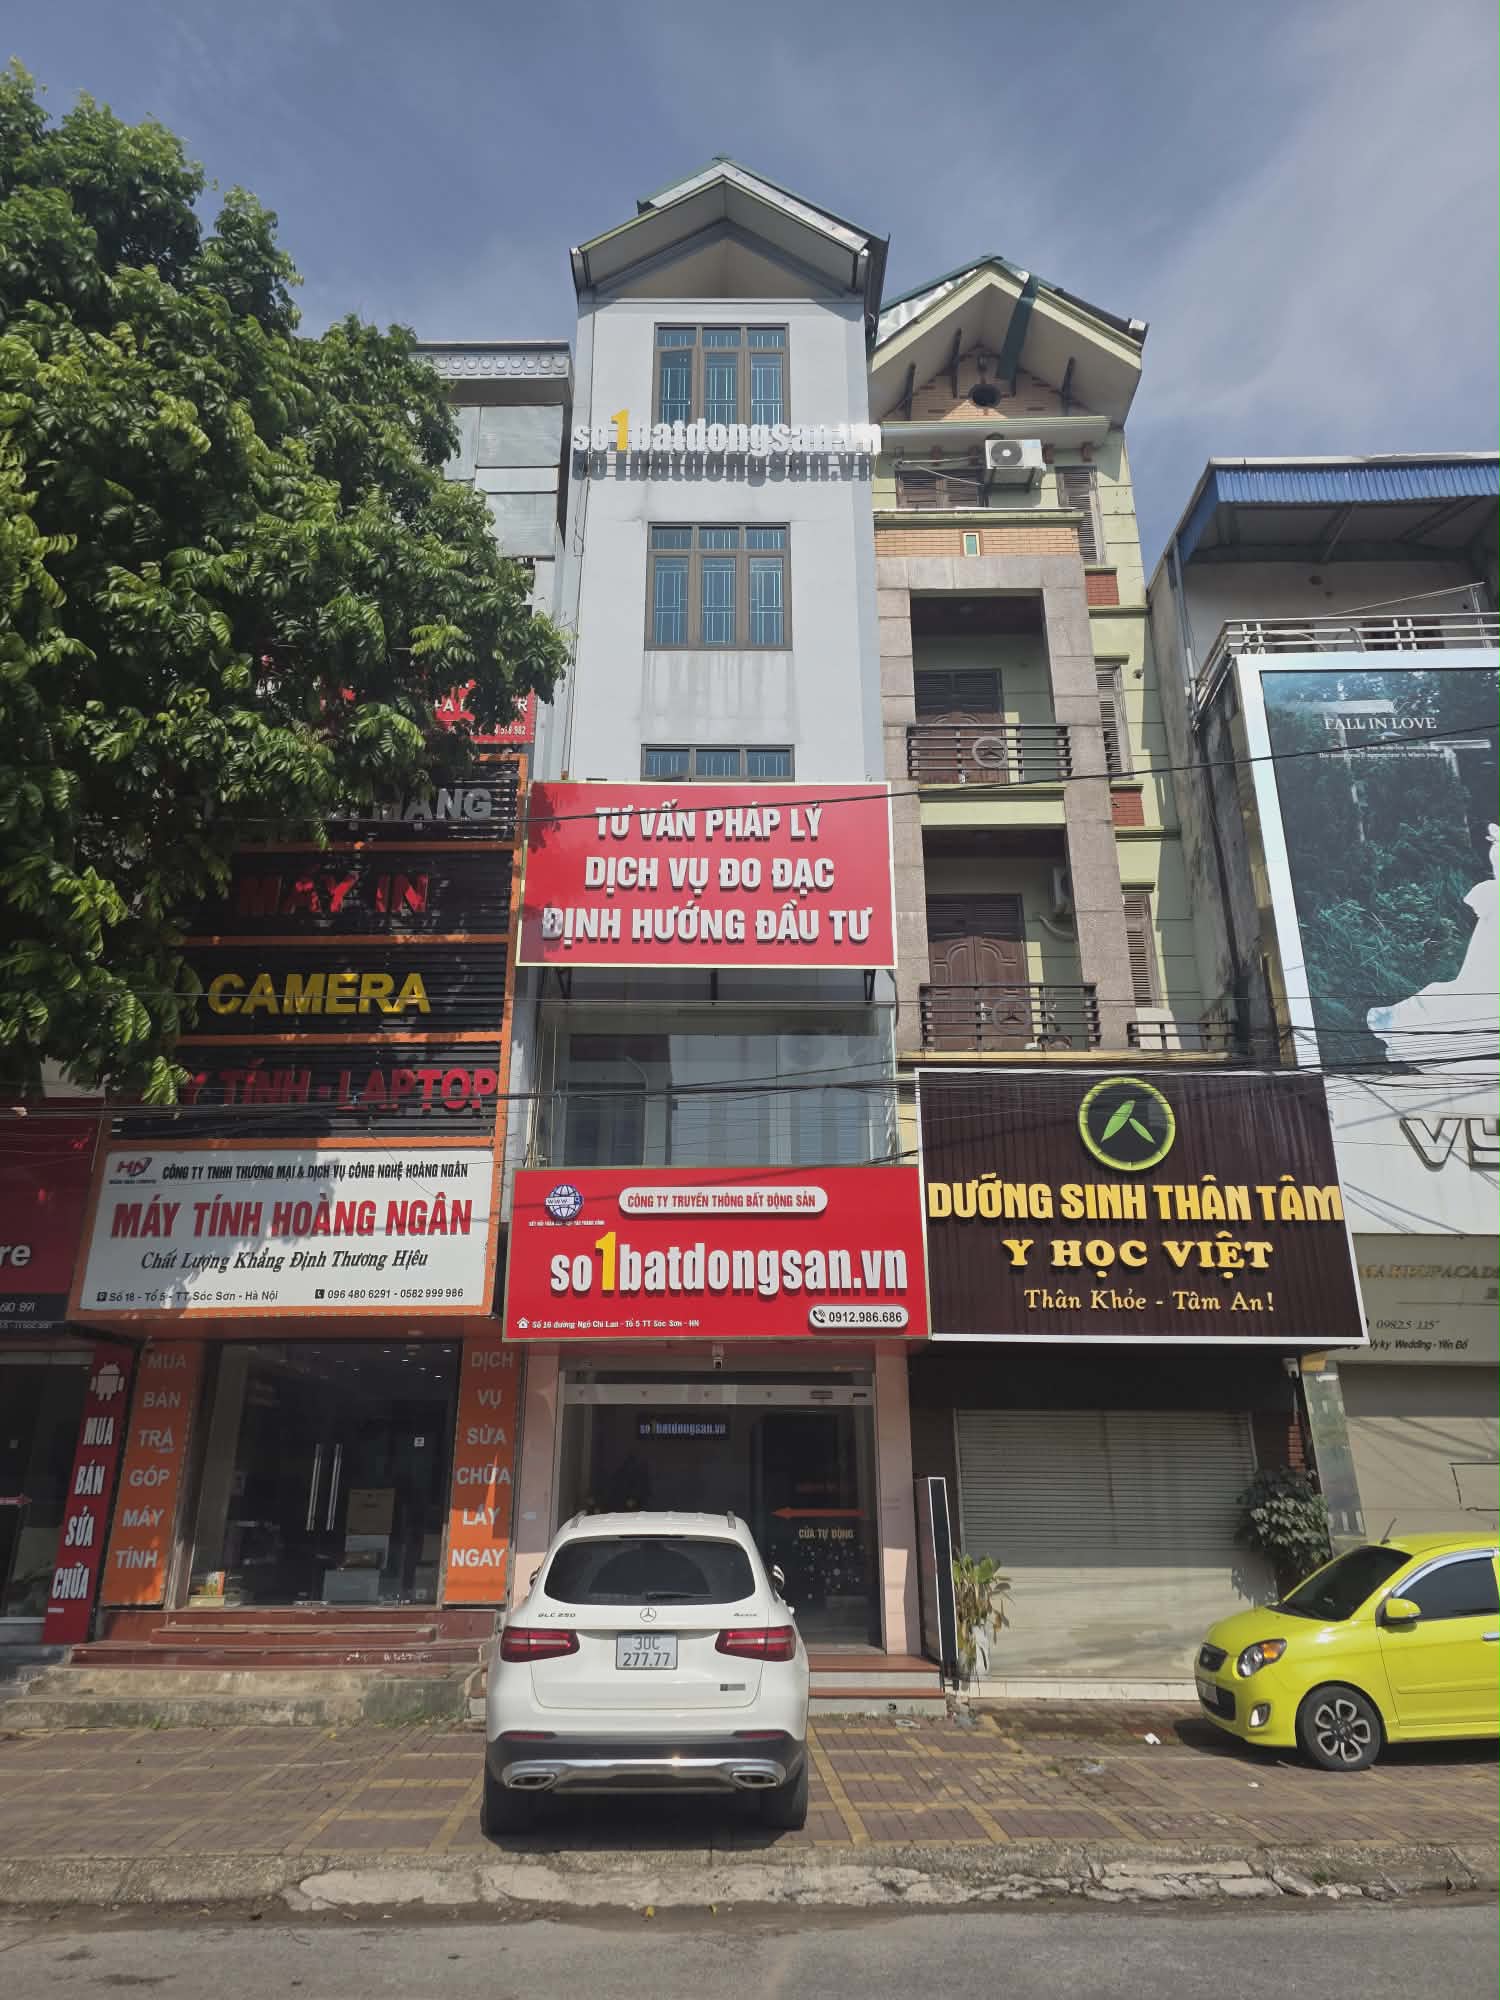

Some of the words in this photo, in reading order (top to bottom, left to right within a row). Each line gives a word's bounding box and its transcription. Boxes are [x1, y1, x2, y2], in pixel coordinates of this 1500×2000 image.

[1368, 717, 1390, 730] IN
[1391, 716, 1437, 729] LOVE
[595, 804, 633, 837] TƯ
[640, 799, 696, 837] VẤN
[705, 802, 780, 837] PHÁP
[790, 802, 822, 837] LÝ
[585, 856, 658, 895] DỊCH
[668, 857, 708, 895] VỤ
[719, 857, 762, 889] ĐO
[771, 857, 834, 896] ĐẠC
[542, 907, 621, 944] ĐỊNH
[632, 901, 745, 940] HƯỚNG
[828, 907, 873, 940] TƯ
[207, 973, 432, 1015] CAMERA
[220, 1058, 312, 1105] TÍNH
[336, 1067, 499, 1111] LAPTOP
[162, 1163, 189, 1180] CÔNG
[191, 1166, 204, 1180] TY
[207, 1165, 233, 1180] TNHH
[236, 1163, 274, 1180] THƯƠNG
[276, 1165, 296, 1182] MẠI
[307, 1165, 331, 1182] DỊCH
[333, 1165, 346, 1182] VỤ
[349, 1162, 375, 1179] CÔNG
[377, 1161, 403, 1181] NGHỆ
[405, 1161, 438, 1179] HOÀNG
[440, 1160, 468, 1178] NGÂN
[628, 1192, 654, 1208] CÔNG
[656, 1195, 669, 1208] TY
[712, 1192, 743, 1208] THÔNG
[746, 1191, 764, 1208] BẤT
[767, 1192, 793, 1210] ĐỘNG
[795, 1191, 816, 1208] SẢN
[928, 1173, 1054, 1219] DƯỠNG
[1060, 1184, 1147, 1220] SINH
[1153, 1174, 1252, 1221] THÂN
[1256, 1175, 1344, 1221] TÂM
[110, 1193, 181, 1238] MÁY
[191, 1193, 262, 1238] TÍNH
[270, 1192, 377, 1238] HOÀNG
[385, 1191, 473, 1236] NGÂN
[141, 1248, 178, 1269] Chất
[181, 1252, 231, 1273] Lượng
[233, 1247, 285, 1272] Khẳng
[289, 1250, 327, 1271] Định
[331, 1251, 388, 1271] Thương
[550, 1231, 908, 1296] so1batdongsan.vn
[1002, 1239, 1034, 1267] Y
[1050, 1239, 1148, 1278] HỌC
[1161, 1231, 1274, 1279] VIỆT
[125, 1292, 135, 1302] 18
[175, 1291, 190, 1302] TT
[192, 1291, 213, 1302] Sóc
[215, 1291, 236, 1301] Sơn
[245, 1291, 258, 1301] Hà
[261, 1290, 279, 1302] Nội
[327, 1289, 346, 1299] 096
[348, 1289, 366, 1299] 480
[368, 1289, 391, 1299] 6291
[400, 1289, 424, 1298] 0582
[425, 1288, 444, 1298] 999
[445, 1288, 464, 1298] 986
[1024, 1289, 1082, 1310] Thân
[1090, 1287, 1147, 1310] Khỏe
[1172, 1290, 1221, 1312] Tâm
[1231, 1291, 1275, 1312] An!
[828, 1311, 903, 1323] 0912.986.686
[148, 1353, 187, 1369] MUA
[471, 1351, 514, 1373] DỊCH
[143, 1387, 181, 1408] BÁN
[477, 1389, 503, 1409] VỤ
[83, 1417, 114, 1445] MUA
[138, 1425, 174, 1448] TRẢ
[466, 1424, 507, 1445] SỬA
[74, 1459, 106, 1495] BÁN
[129, 1465, 170, 1487] GÓP
[456, 1463, 512, 1486] CHỮA
[122, 1504, 164, 1527] MÁY
[115, 1545, 159, 1569] TÍNH
[451, 1548, 505, 1568] NGAY
[52, 1562, 90, 1600] CHỮA
[633, 1635, 661, 1650] 30C
[622, 1652, 671, 1667] 277.77
